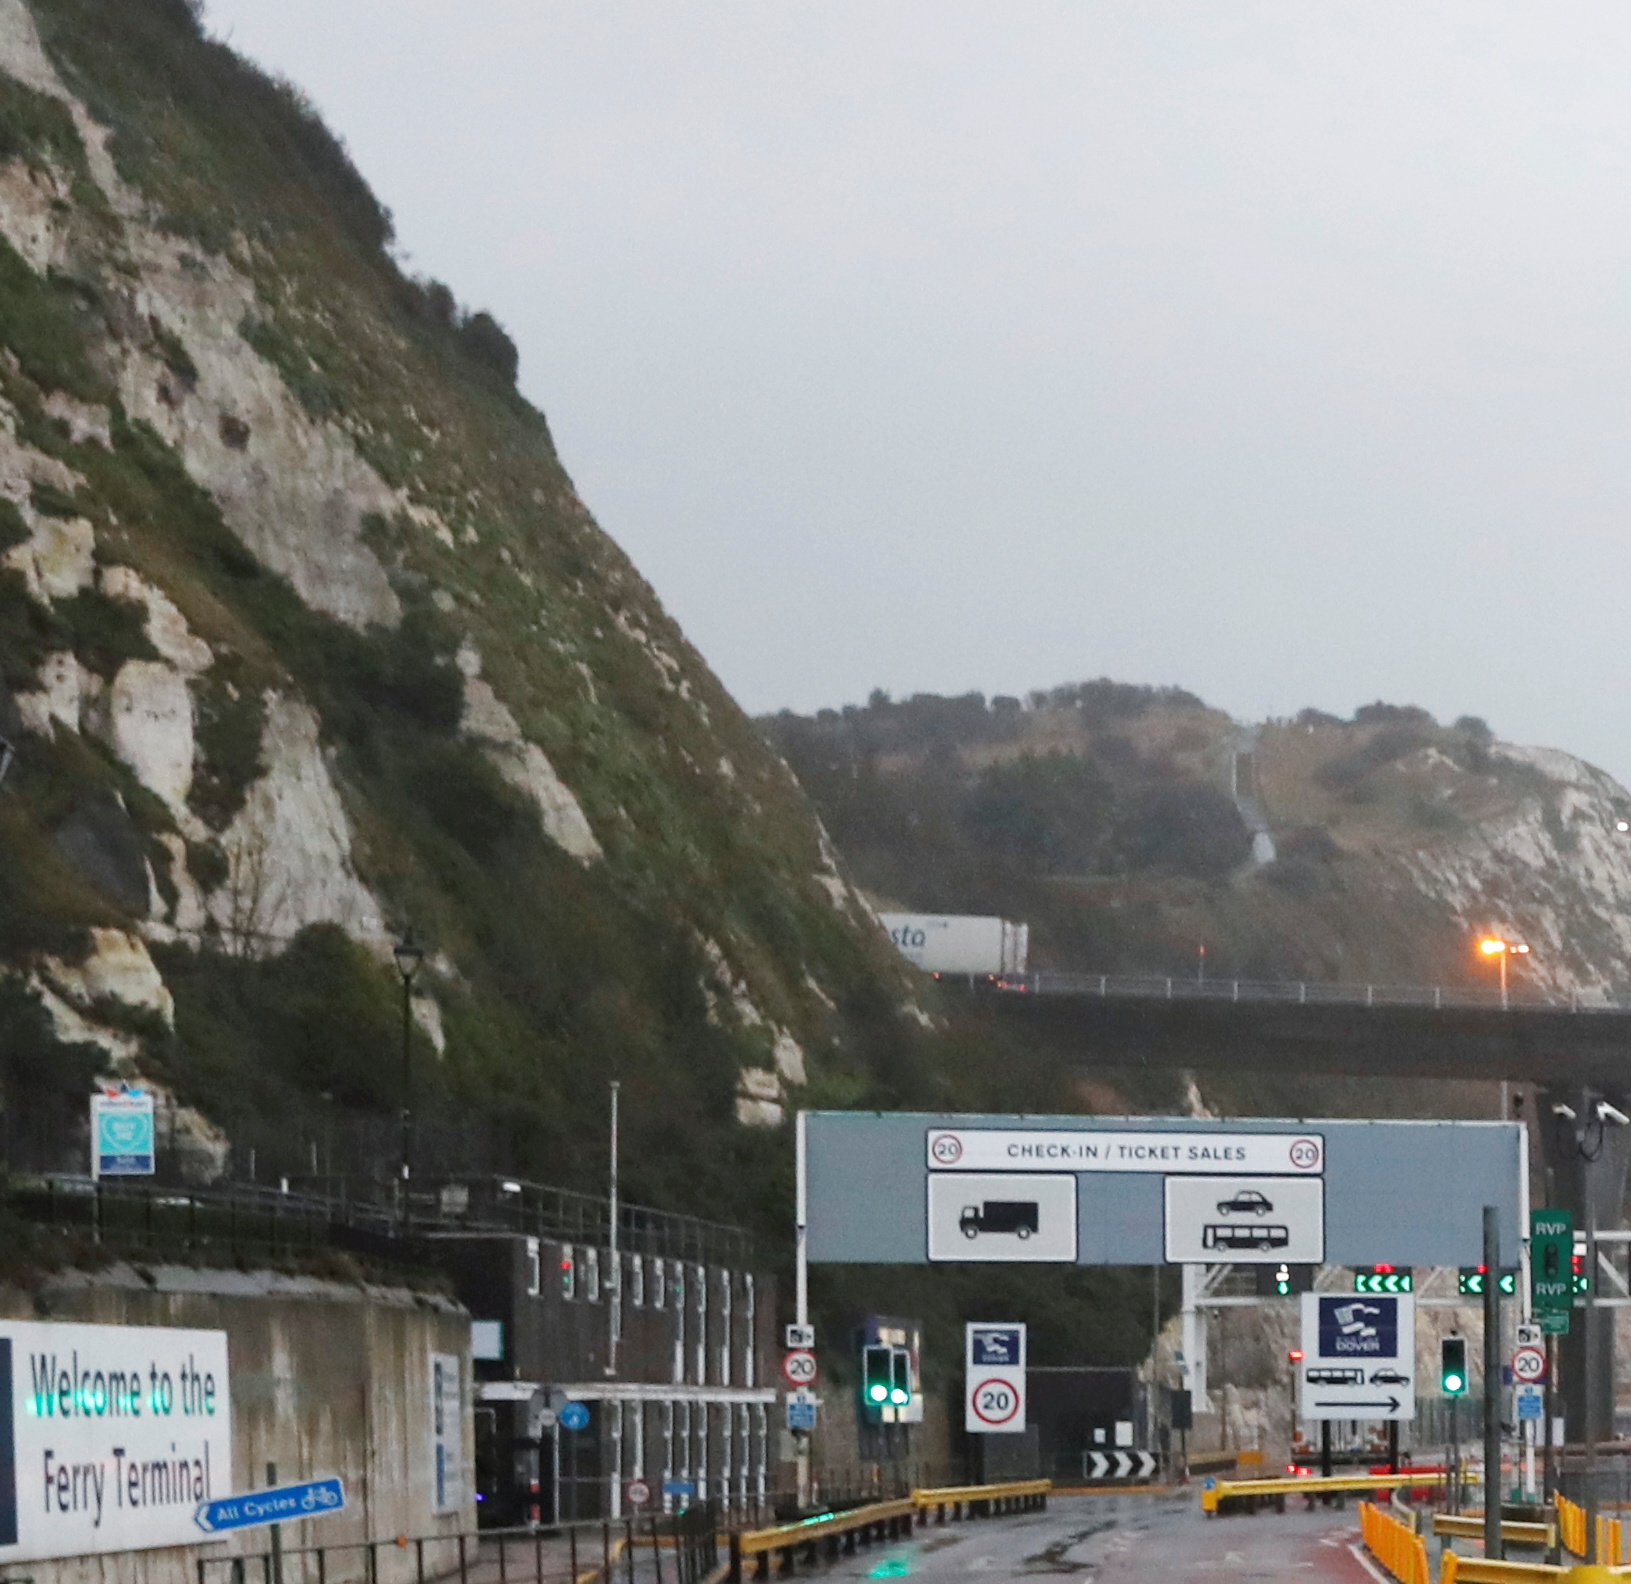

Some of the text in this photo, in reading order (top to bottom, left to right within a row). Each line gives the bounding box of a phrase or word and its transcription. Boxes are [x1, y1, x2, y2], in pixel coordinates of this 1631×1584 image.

[937, 1144, 957, 1157] 20
[1007, 1143, 1098, 1159] CHECK-IN
[1118, 1145, 1182, 1161] TICKET
[1188, 1146, 1247, 1161] SALES
[1295, 1148, 1314, 1161] 20
[1535, 1222, 1567, 1236] RVP
[1535, 1282, 1567, 1296] RVP
[789, 1360, 815, 1376] 20
[1517, 1356, 1540, 1373] 20
[29, 1351, 215, 1418] Welcome to the
[982, 1391, 1010, 1411] 20
[44, 1440, 212, 1528] Ferry Terminal
[216, 1494, 297, 1522] All Cycles
